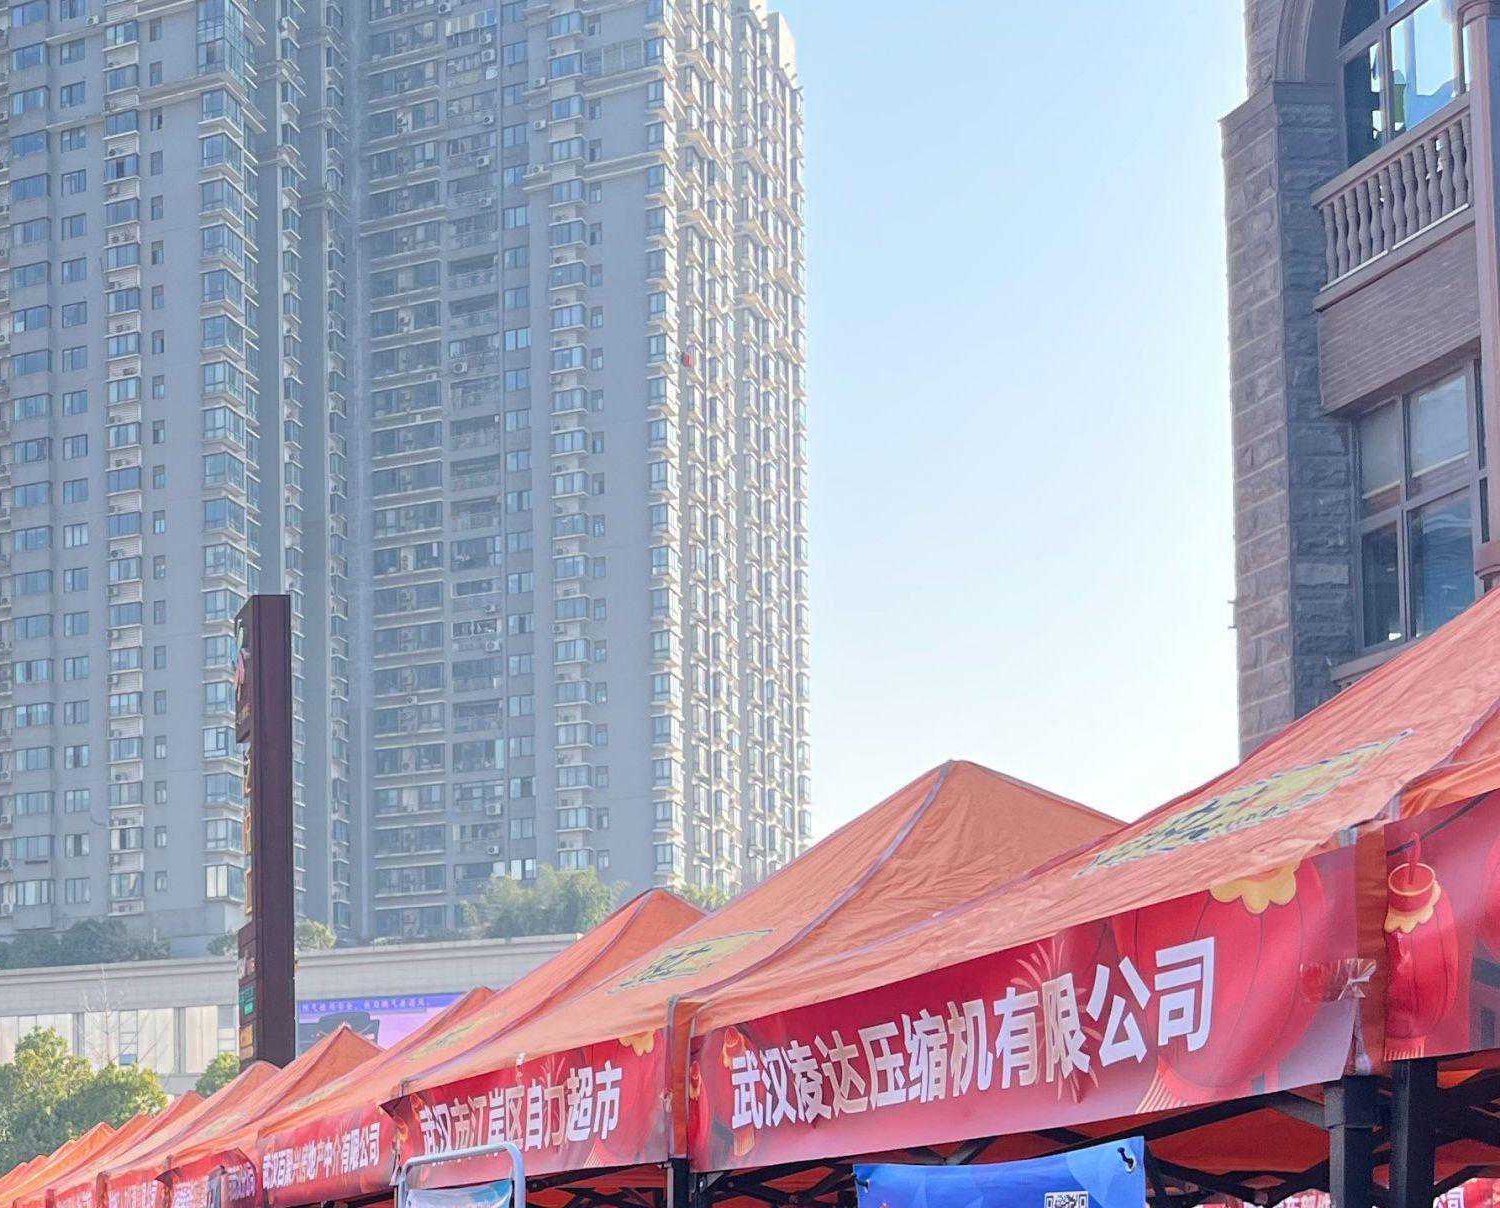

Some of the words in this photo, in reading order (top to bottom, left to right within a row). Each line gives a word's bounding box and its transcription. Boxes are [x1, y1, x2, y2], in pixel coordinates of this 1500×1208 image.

[731, 937, 1216, 1131] 武汉凌达压缩机有限公司
